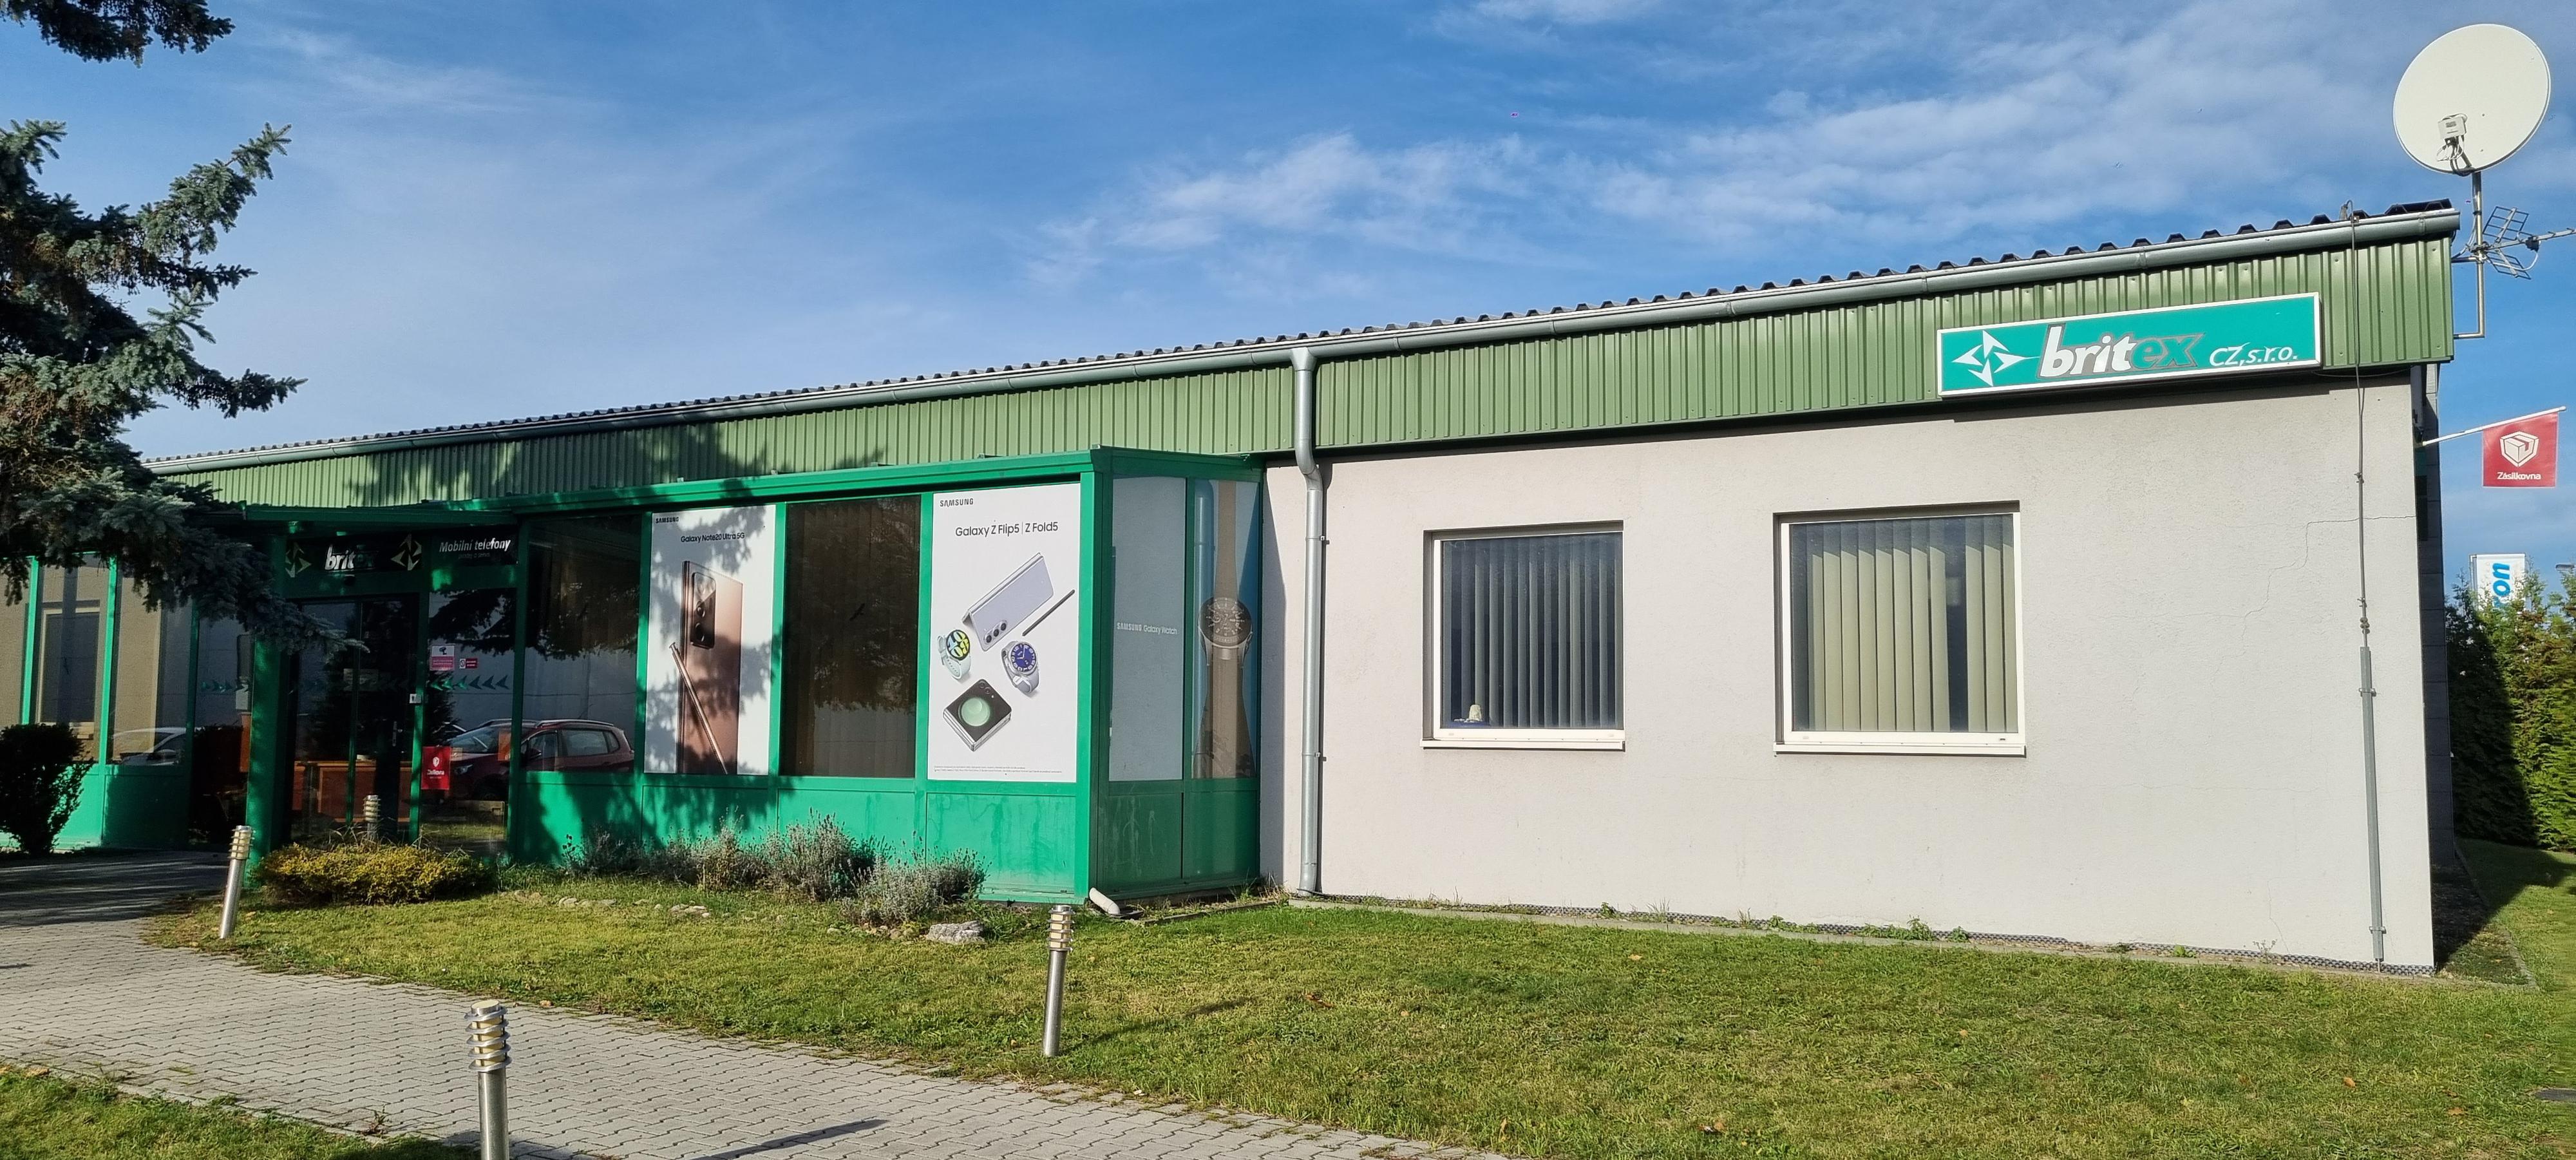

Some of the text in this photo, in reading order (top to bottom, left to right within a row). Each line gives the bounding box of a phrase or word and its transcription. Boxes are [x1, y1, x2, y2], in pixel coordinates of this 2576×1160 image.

[2038, 324, 2205, 378] britex
[2497, 471, 2541, 480] Zásilkovna
[940, 498, 974, 507] SAMSUNG
[956, 522, 1058, 537] Galaxy Z Flip5 Z Fold5
[474, 537, 511, 551] telefony
[1117, 622, 1177, 635] SAMSUNG Galaxy Watch
